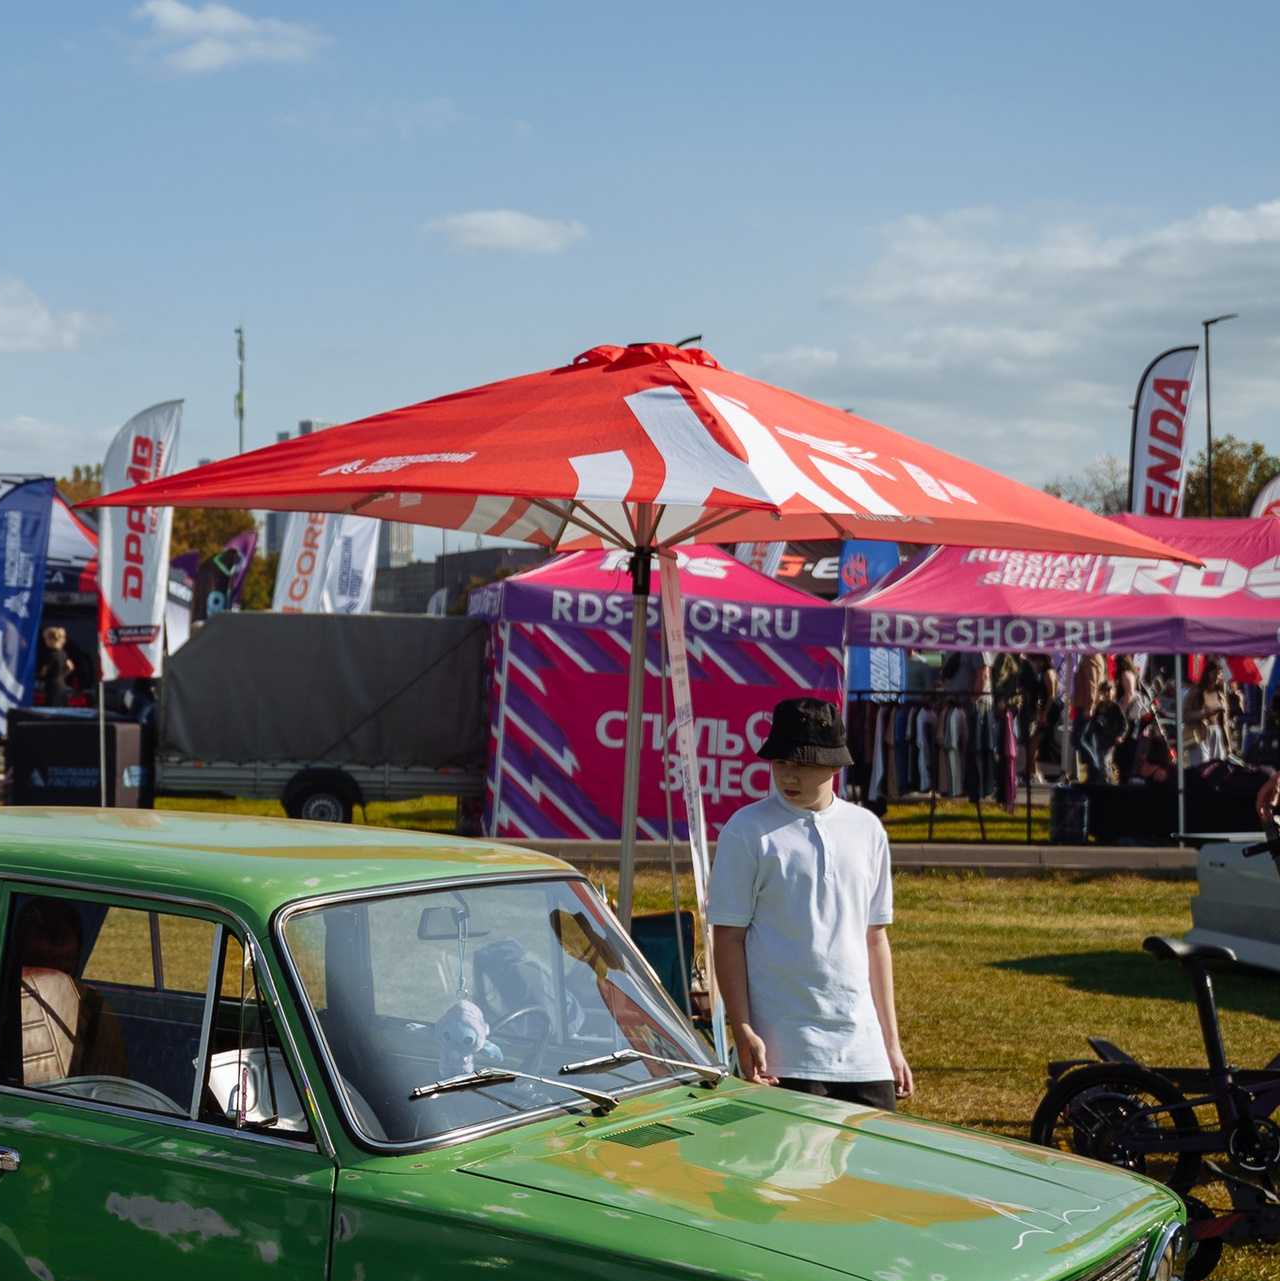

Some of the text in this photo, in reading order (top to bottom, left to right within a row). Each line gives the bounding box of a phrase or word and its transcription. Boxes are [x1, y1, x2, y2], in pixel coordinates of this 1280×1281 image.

[966, 548, 1093, 569] RUSSIAN
[1003, 563, 1082, 578] DRIFT
[982, 571, 1083, 592] SERIES
[551, 589, 800, 640] RDS-SOP.RU
[870, 612, 1112, 651] RDS-SHOP.RU
[658, 756, 774, 804] ЗДЕС
